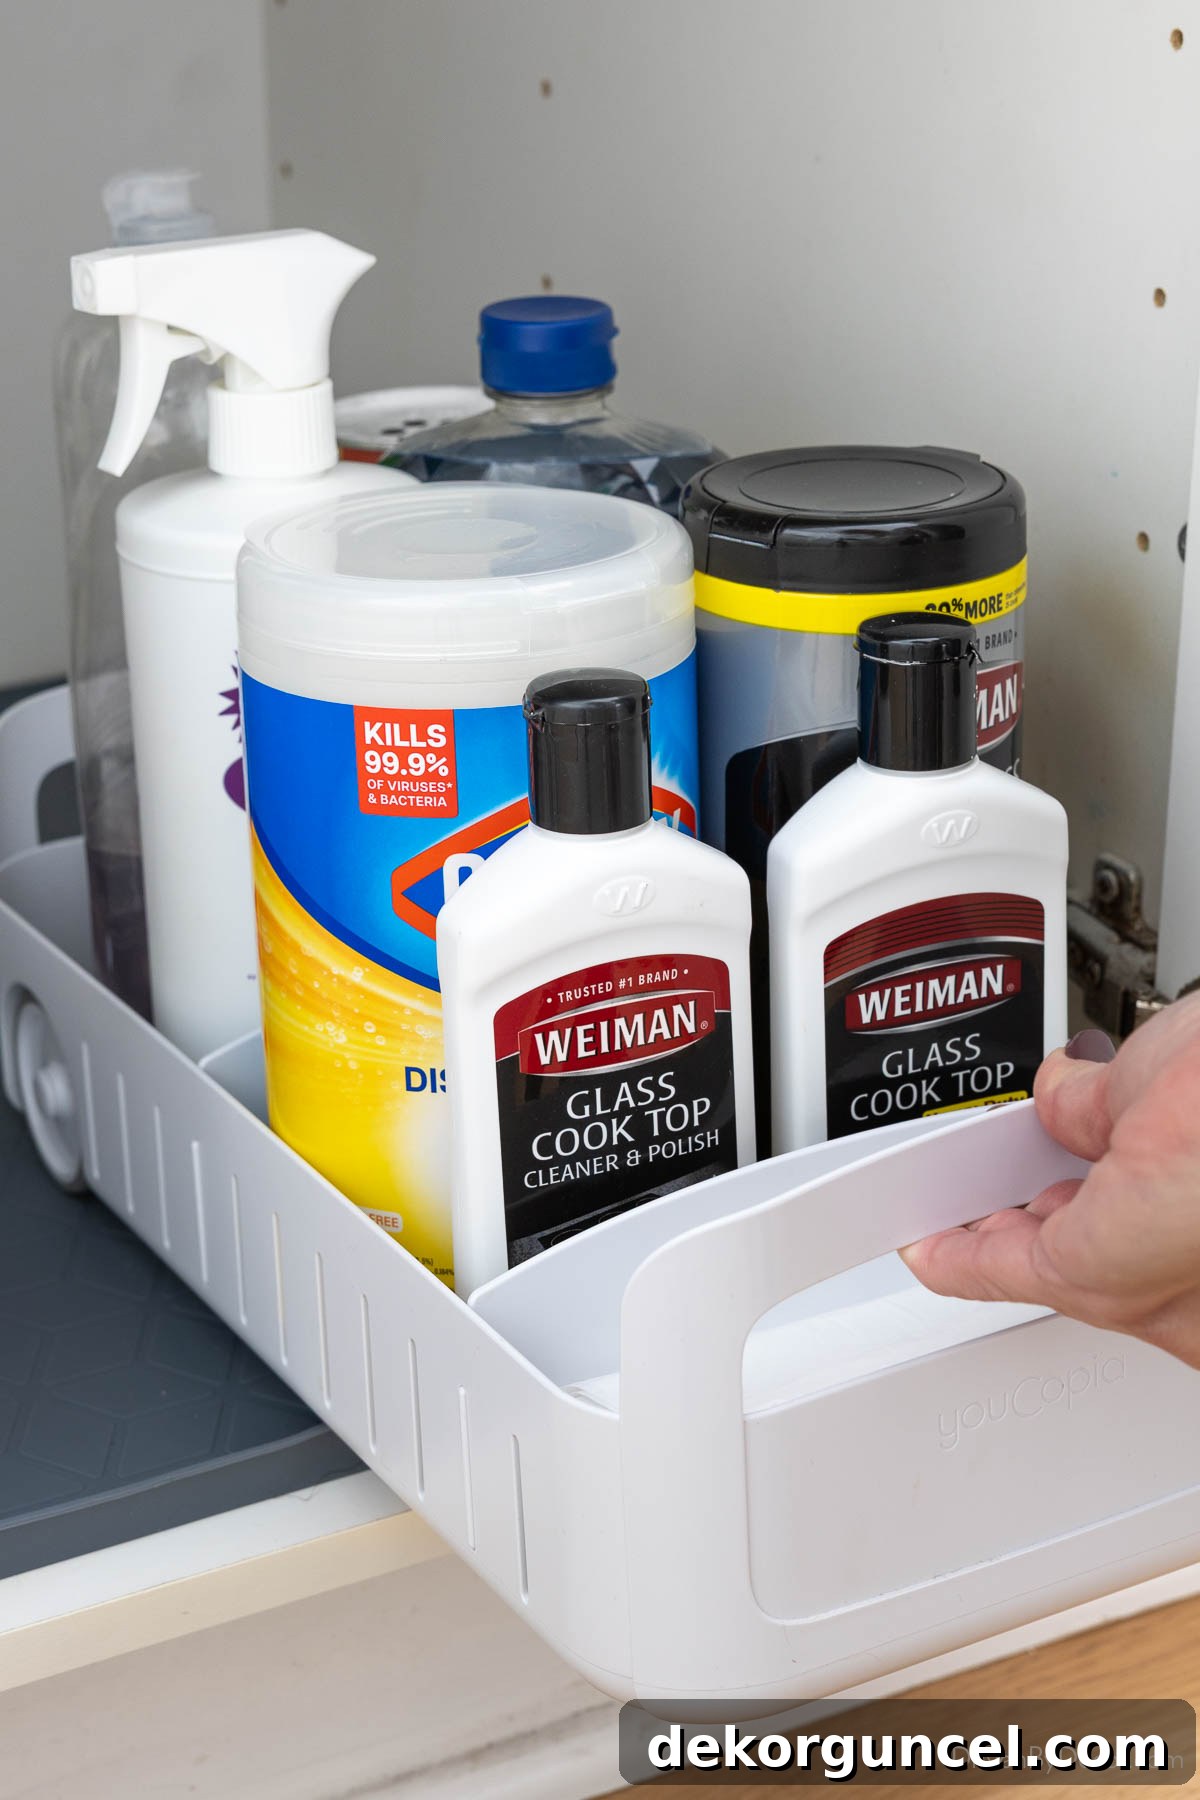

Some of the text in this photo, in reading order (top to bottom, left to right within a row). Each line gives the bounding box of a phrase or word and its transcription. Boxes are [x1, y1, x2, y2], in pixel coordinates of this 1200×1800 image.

[965, 593, 1003, 620] MORE
[985, 628, 1013, 650] BRAND
[976, 673, 1018, 730] MAN
[364, 720, 447, 748] KILLS
[364, 750, 449, 777] 99.9%
[367, 778, 384, 790] OF
[367, 792, 447, 807] & BACTERIA
[558, 968, 678, 1004] TRUSTED #1 BRAND
[881, 1033, 981, 1079] GLASS
[566, 1071, 677, 1121] GLASS
[850, 1076, 942, 1122] COOK
[951, 1061, 1015, 1098] TOP
[531, 1096, 711, 1161] COOK TOP
[523, 1128, 720, 1189] CLEANER & POLISH
[938, 1352, 1127, 1451] youCopia
